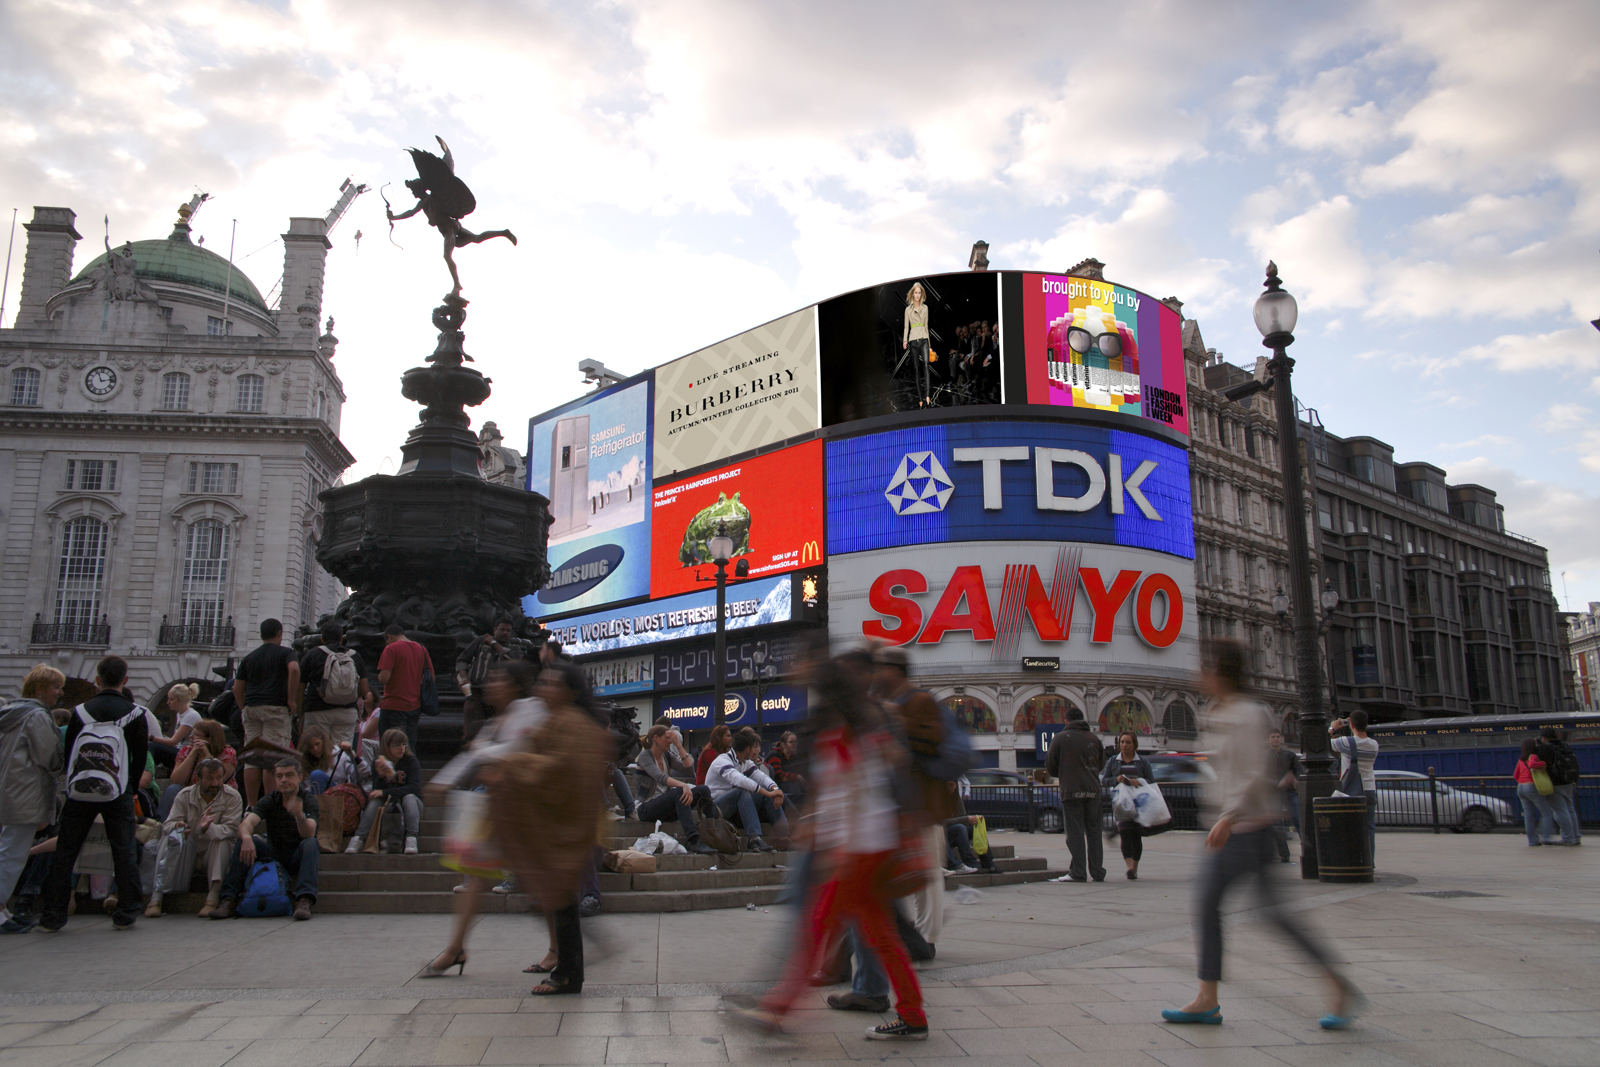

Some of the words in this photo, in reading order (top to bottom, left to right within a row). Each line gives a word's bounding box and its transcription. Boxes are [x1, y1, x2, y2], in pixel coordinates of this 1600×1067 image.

[1042, 277, 1087, 299] brought
[1089, 284, 1101, 300] to
[1103, 289, 1124, 305] you
[1127, 293, 1141, 312] by
[697, 372, 719, 386] LIVE
[723, 350, 779, 376] STREAMING
[669, 366, 799, 424] BURBERRY
[1150, 386, 1181, 406] LONDON
[1151, 397, 1184, 417] FASHION
[668, 408, 733, 436] AUTUMN/WINTER
[735, 392, 782, 412] COLLECTION
[784, 386, 799, 396] 2011
[1151, 408, 1174, 424] WEEK
[590, 430, 647, 459] Refrigerator
[591, 423, 626, 445] SAMSUNG
[654, 491, 664, 499] THE
[664, 485, 685, 497] PRINCE'S
[685, 475, 718, 490] RAINFORESTS
[718, 468, 741, 481] PROJECT
[953, 446, 1164, 522] TDK
[772, 553, 783, 562] SIGN
[792, 550, 798, 558] AT
[546, 558, 609, 590] SAMSUNG
[862, 547, 1184, 660] SANYO
[553, 626, 578, 645] THE
[581, 617, 632, 642] WORLD'S
[634, 611, 666, 633] MOST
[667, 603, 731, 628] REFRESHIG
[663, 705, 709, 719] pharmacy
